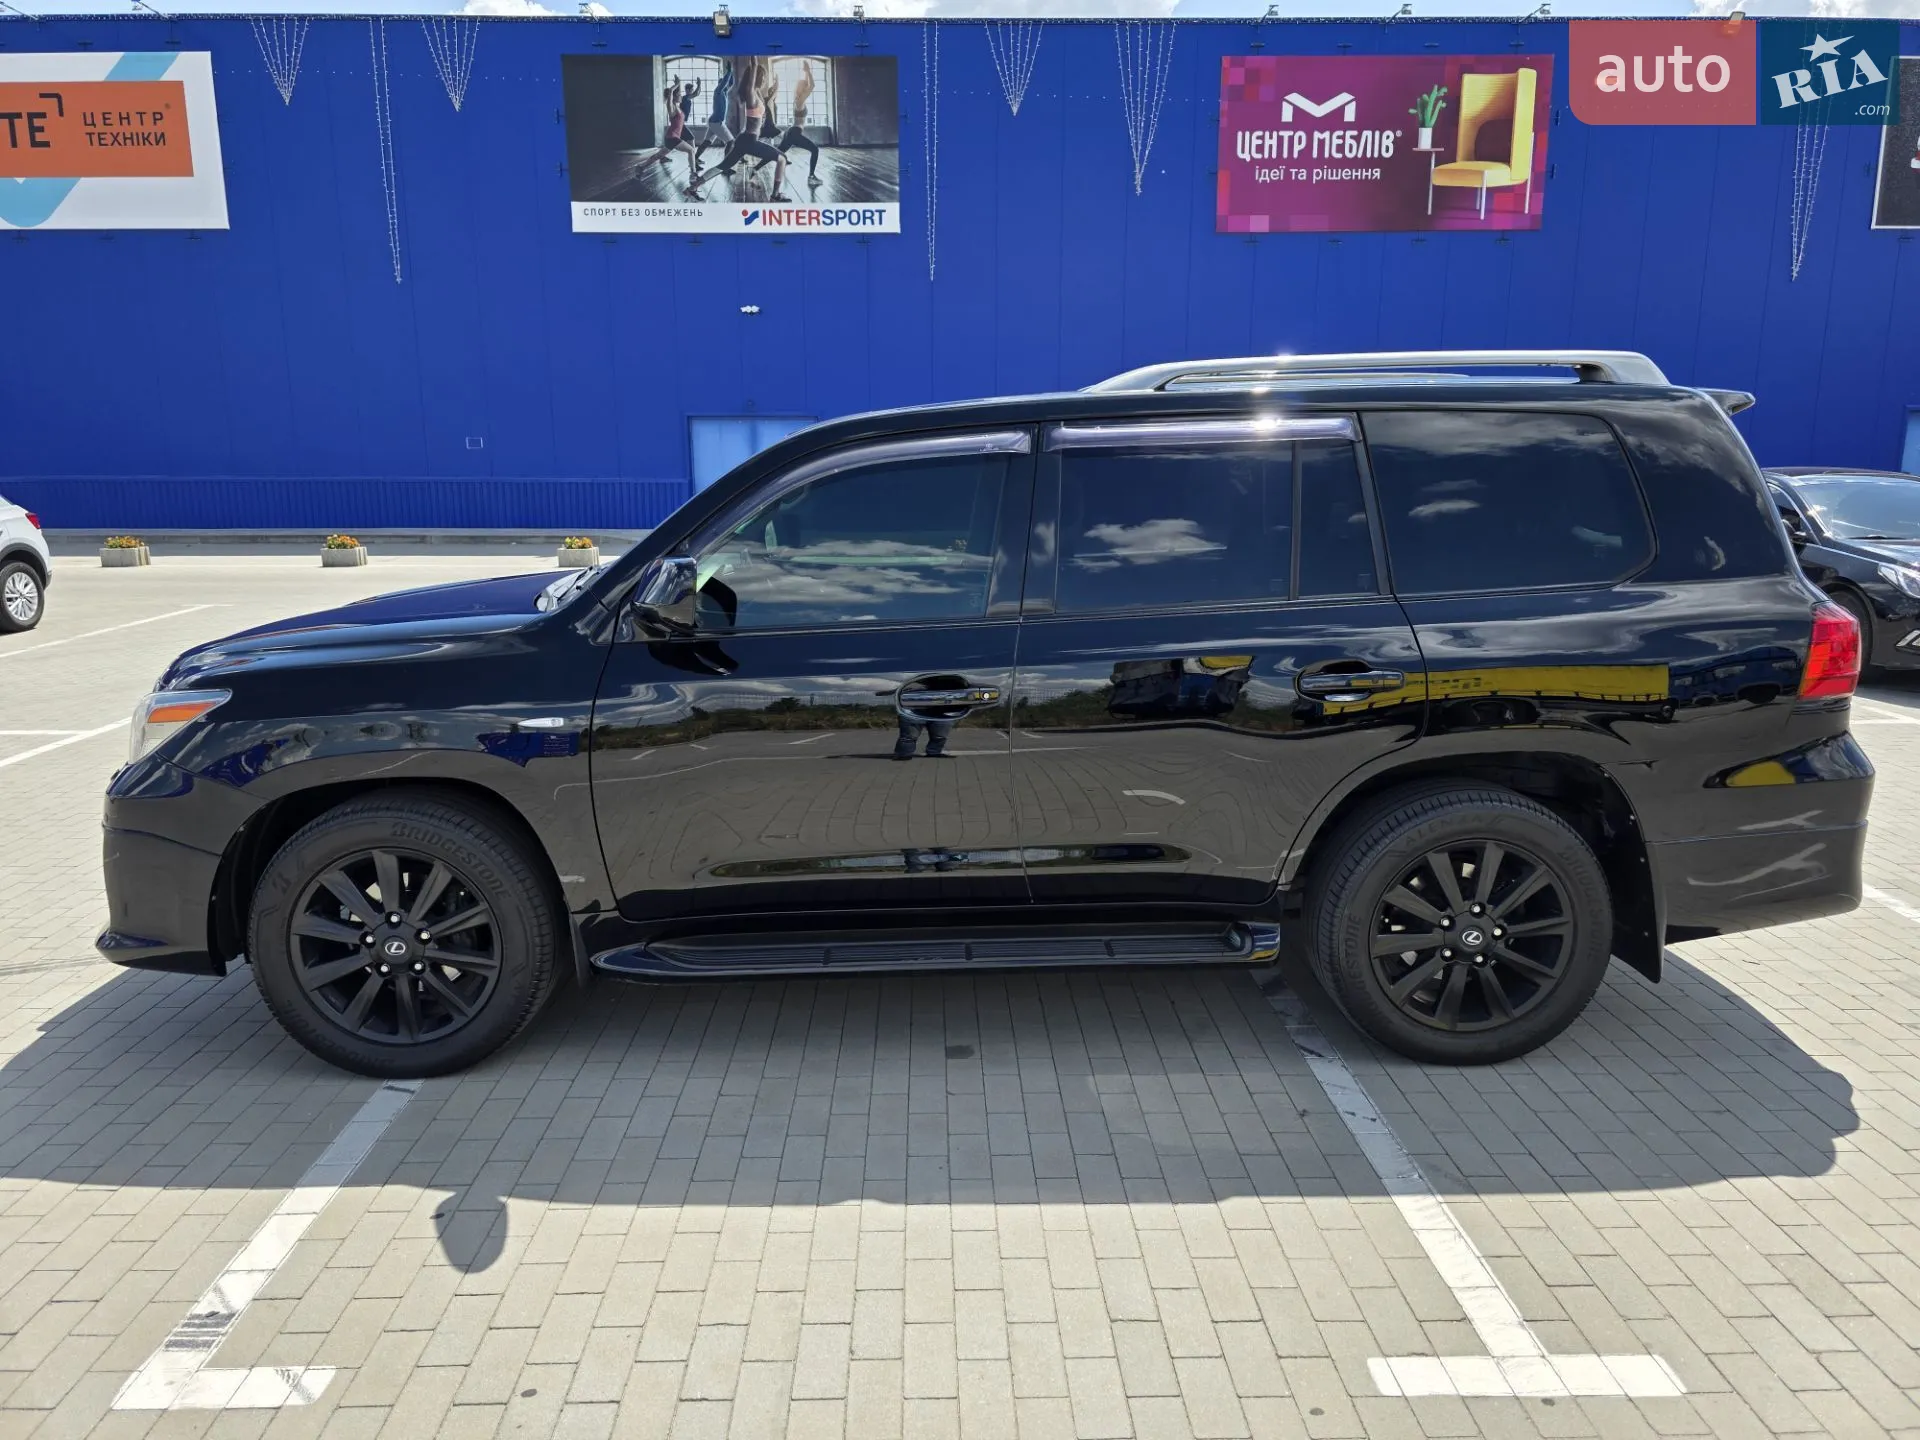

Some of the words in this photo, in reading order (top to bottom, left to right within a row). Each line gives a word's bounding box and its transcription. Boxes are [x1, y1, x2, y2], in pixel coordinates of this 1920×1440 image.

[82, 111, 164, 129] ЦЕНТР
[85, 132, 167, 147] ТЕХНІКИ
[1255, 165, 1285, 183] ідеї
[1290, 168, 1307, 181] та
[1312, 165, 1381, 184] рішення
[583, 207, 616, 217] СПОРТ
[621, 207, 640, 217] БЕЗ
[644, 207, 703, 217] ОБМЕЖЕНЬ
[762, 208, 887, 227] INTERSPORT
[390, 820, 513, 901] BRIDGESTONE
